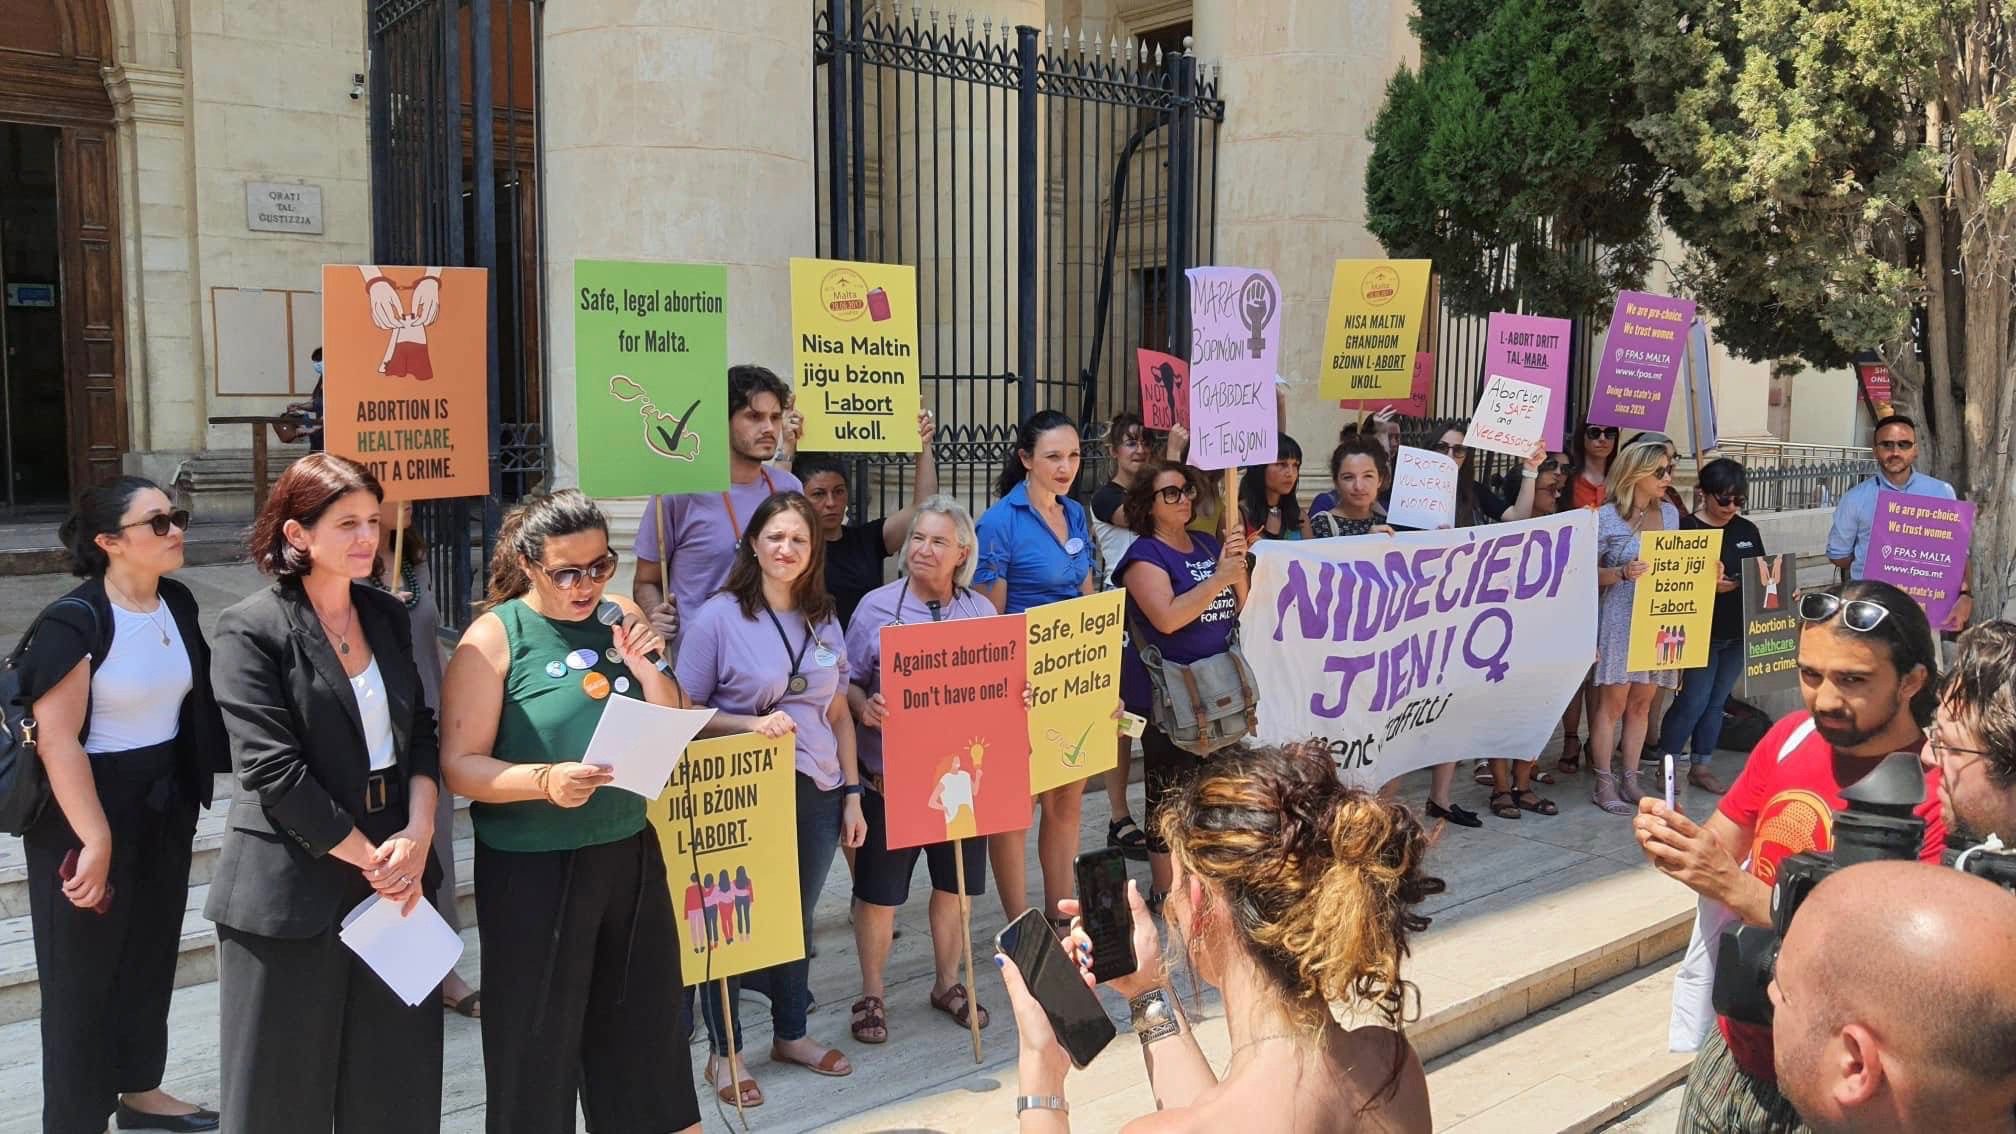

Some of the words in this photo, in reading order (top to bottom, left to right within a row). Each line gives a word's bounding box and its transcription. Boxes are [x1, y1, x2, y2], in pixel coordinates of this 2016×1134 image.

[269, 191, 300, 201] QRATI
[581, 288, 619, 315] Safe,
[624, 289, 659, 317] legal
[664, 290, 722, 313] abortion
[1192, 276, 1241, 322] MARA
[1626, 303, 1636, 314] We
[1638, 306, 1648, 318] are
[1345, 315, 1366, 329] NISA
[1370, 315, 1405, 329] MALTIN
[1624, 322, 1634, 334] We
[1635, 325, 1651, 337] trust
[619, 330, 640, 352] for
[645, 330, 689, 352] Malta.
[802, 334, 844, 354] Nisa
[851, 336, 910, 356] Maltin
[1500, 331, 1534, 348] L-ABORT
[1536, 335, 1559, 349] DRITT
[1333, 352, 1364, 369] BŻONN
[1366, 354, 1406, 369] L-ABORT
[1507, 350, 1549, 368] TAL-MARA.
[1626, 349, 1644, 360] FPAS
[1646, 352, 1670, 364] MALTA
[802, 363, 840, 388] jiġu
[846, 364, 904, 384] bżonn
[1351, 375, 1382, 388] UKOLL.
[825, 391, 893, 412] l-abort
[1192, 376, 1266, 414] TQABBDEK
[1488, 378, 1544, 406] Abortion
[1623, 387, 1633, 396] the
[1652, 391, 1661, 402] job
[357, 399, 430, 422] ABORTION
[435, 398, 448, 419] IS
[835, 420, 886, 440] ukoll.
[1497, 416, 1512, 426] and
[358, 428, 455, 453] HEALTHCARE,
[392, 460, 402, 481] A
[406, 458, 455, 480] CRIME.
[1888, 502, 1900, 514] We
[1902, 506, 1914, 516] are
[1916, 508, 1960, 522] pro-choice.
[1888, 520, 1900, 532] We
[1902, 523, 1922, 536] trust
[1924, 528, 1954, 540] women.
[1656, 536, 1708, 550] Kulħadd
[1894, 547, 1917, 558] FPAS
[1920, 551, 1952, 564] MALTA
[1651, 556, 1683, 576] jista'
[1684, 556, 1706, 574] jiġi
[1884, 564, 1944, 580] www.fpas.mt
[1273, 525, 1574, 642] NIDDEĊIEDI
[1655, 578, 1694, 592] bżonn
[1910, 586, 1932, 598] state's
[1934, 588, 1945, 600] job
[1650, 598, 1697, 614] l-abort.
[1029, 618, 1074, 645] Safe,
[1080, 604, 1120, 634] legal
[1201, 612, 1218, 623] FOR
[1748, 618, 1786, 636] Abortion
[1788, 616, 1796, 628] is
[893, 648, 947, 676] Against
[952, 640, 1016, 667] abortion?
[1033, 644, 1107, 676] abortion
[1310, 626, 1456, 718] JIEN!
[1748, 663, 1764, 676] not
[1765, 664, 1771, 673] a
[904, 685, 940, 710] Don't
[944, 682, 977, 705] have
[980, 678, 1008, 701] one!
[1032, 686, 1058, 707] for
[1063, 671, 1111, 698] Malta
[730, 747, 778, 777] JISTA'
[668, 789, 698, 822] JIĠI
[704, 784, 758, 816] BŻONN
[678, 819, 752, 855] L-ABORT.
